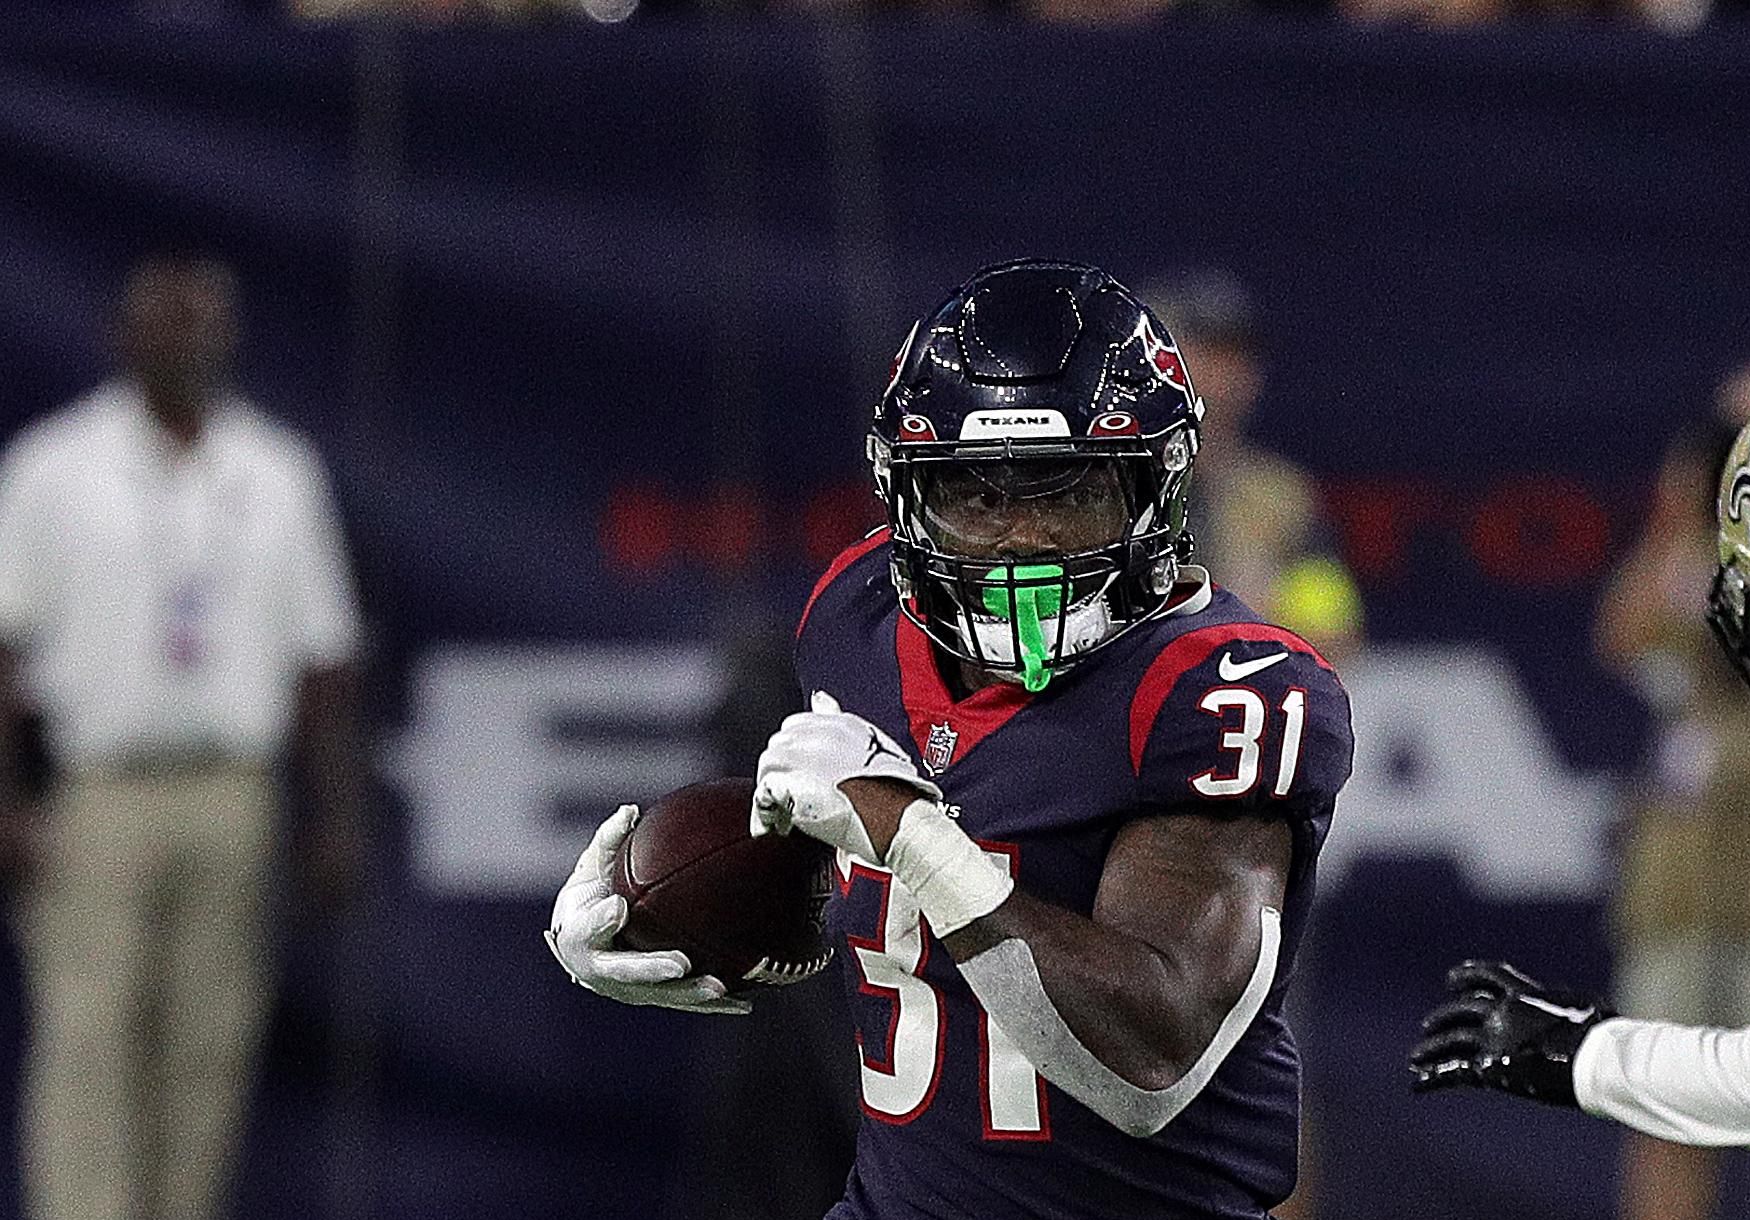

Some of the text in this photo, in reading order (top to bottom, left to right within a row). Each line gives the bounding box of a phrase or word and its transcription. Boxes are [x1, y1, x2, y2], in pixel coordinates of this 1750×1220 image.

[976, 416, 1051, 426] TEXANS
[1190, 686, 1308, 798] 31
[834, 838, 1052, 1141] 31
